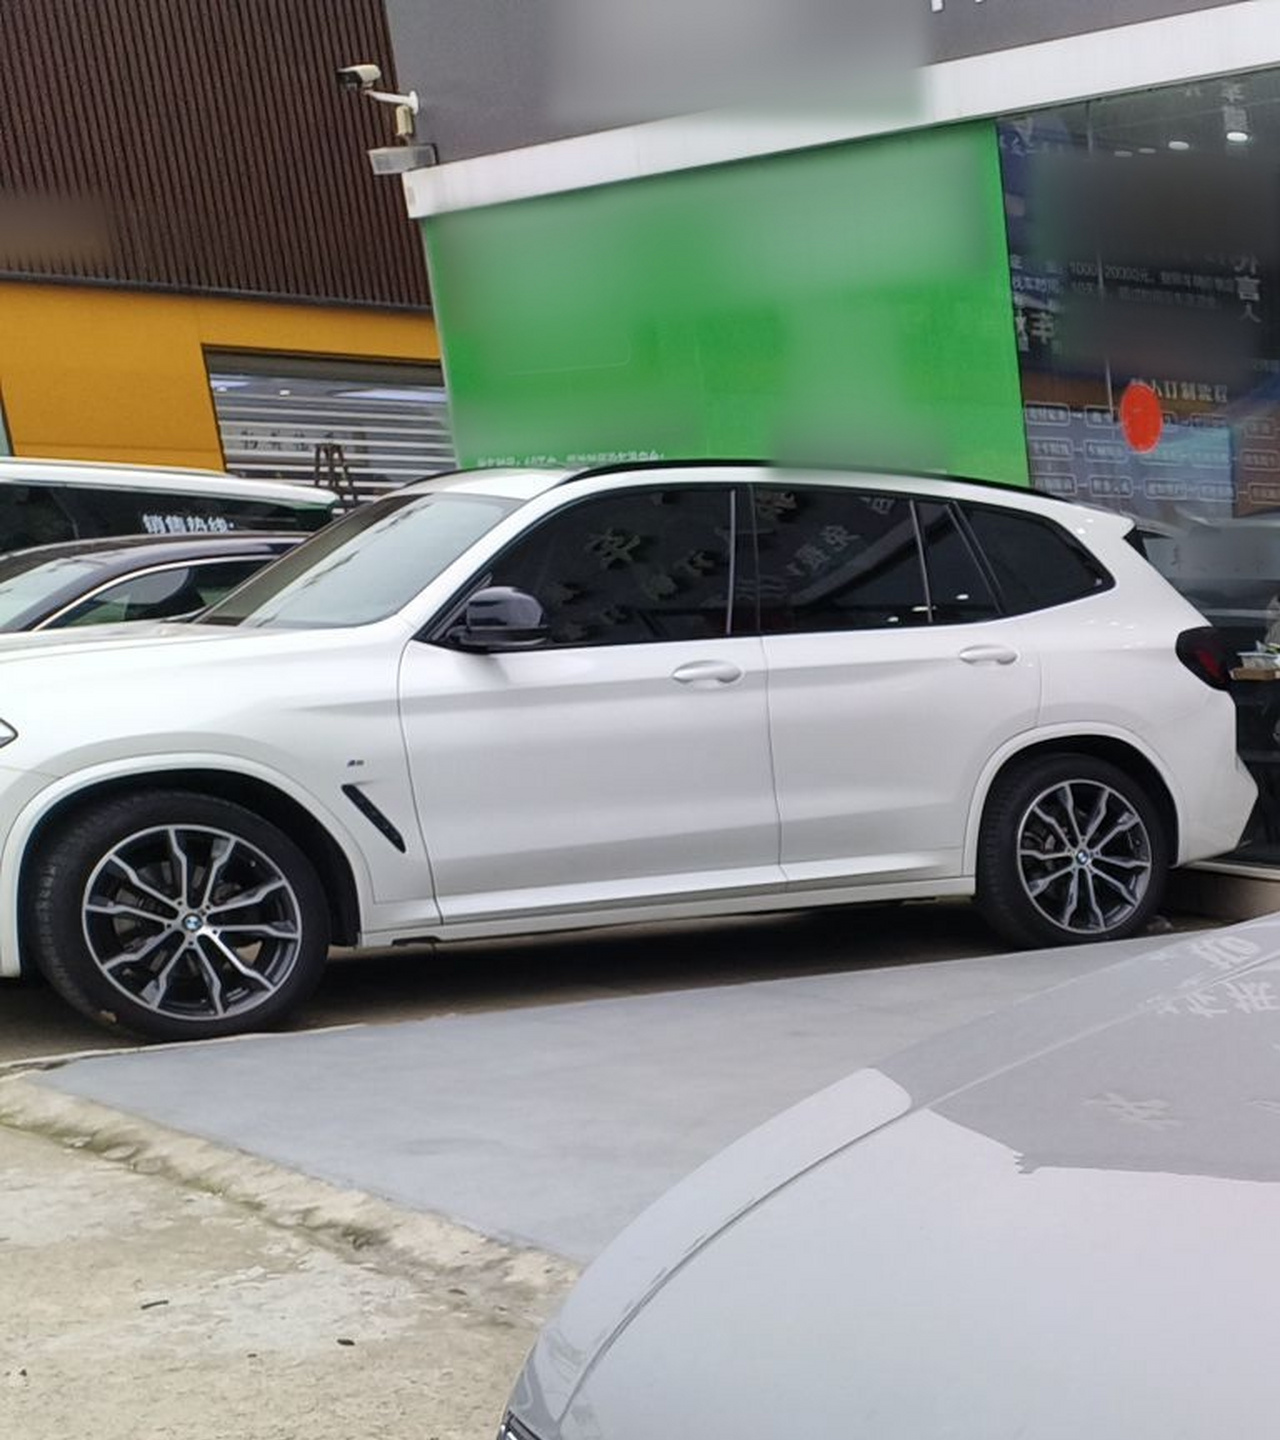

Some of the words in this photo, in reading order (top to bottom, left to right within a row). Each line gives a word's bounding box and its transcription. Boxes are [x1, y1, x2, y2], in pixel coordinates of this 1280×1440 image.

[1130, 378, 1228, 403] 人订制流程
